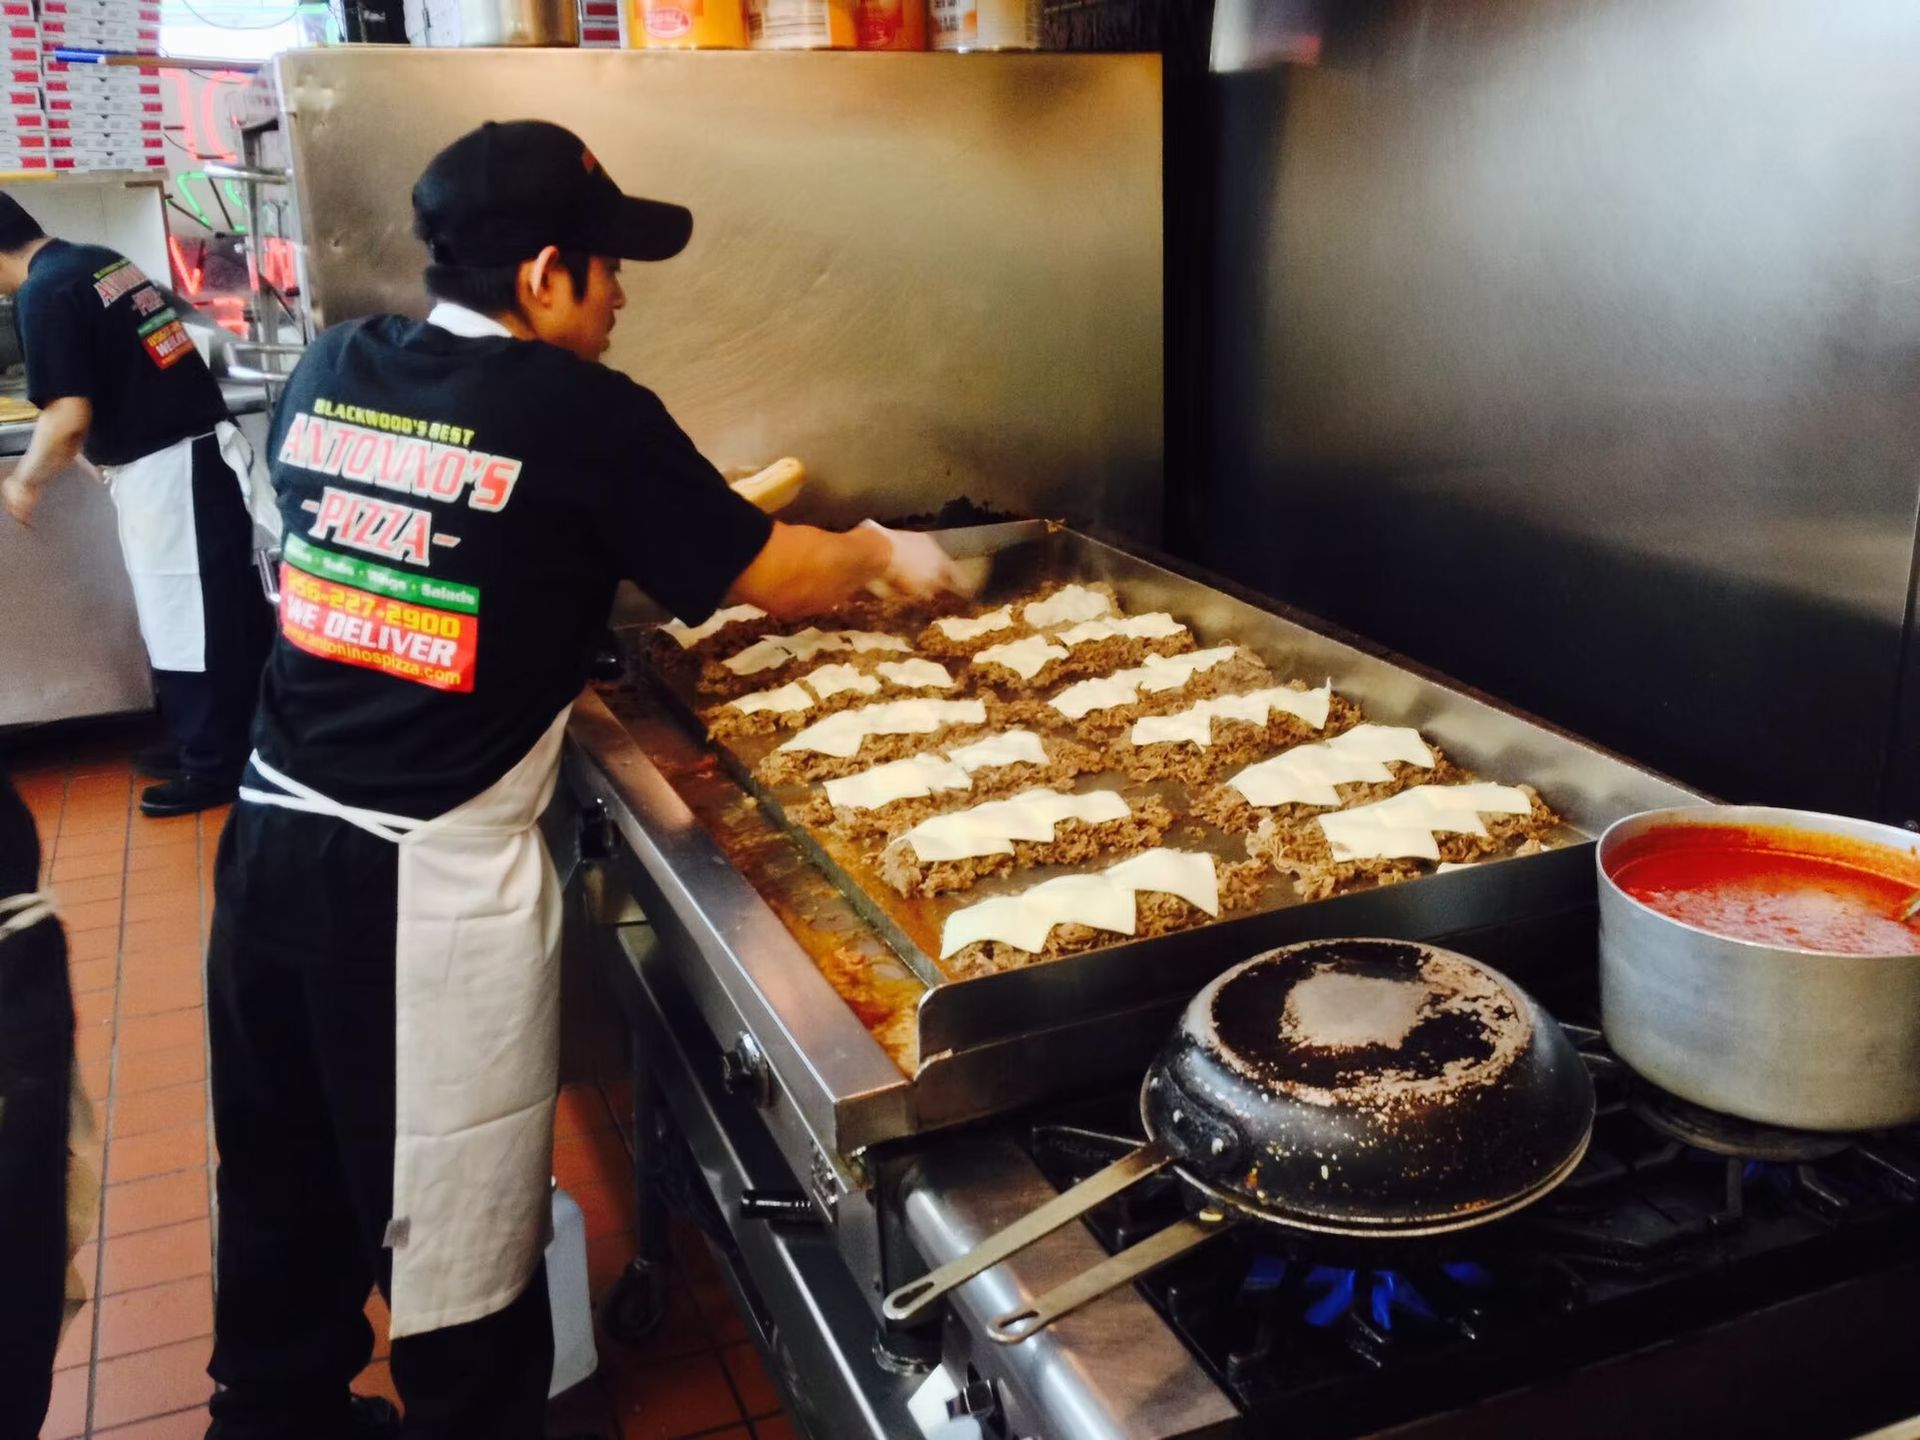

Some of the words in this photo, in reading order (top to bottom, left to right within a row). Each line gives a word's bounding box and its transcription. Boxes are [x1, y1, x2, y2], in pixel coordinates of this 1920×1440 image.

[314, 398, 428, 437] BLACKWOOD'S
[428, 422, 475, 447] BEST
[279, 412, 523, 513] ANTONINO'S
[421, 583, 475, 605] Salads
[287, 594, 322, 630] WE
[323, 610, 459, 667] DELIVER
